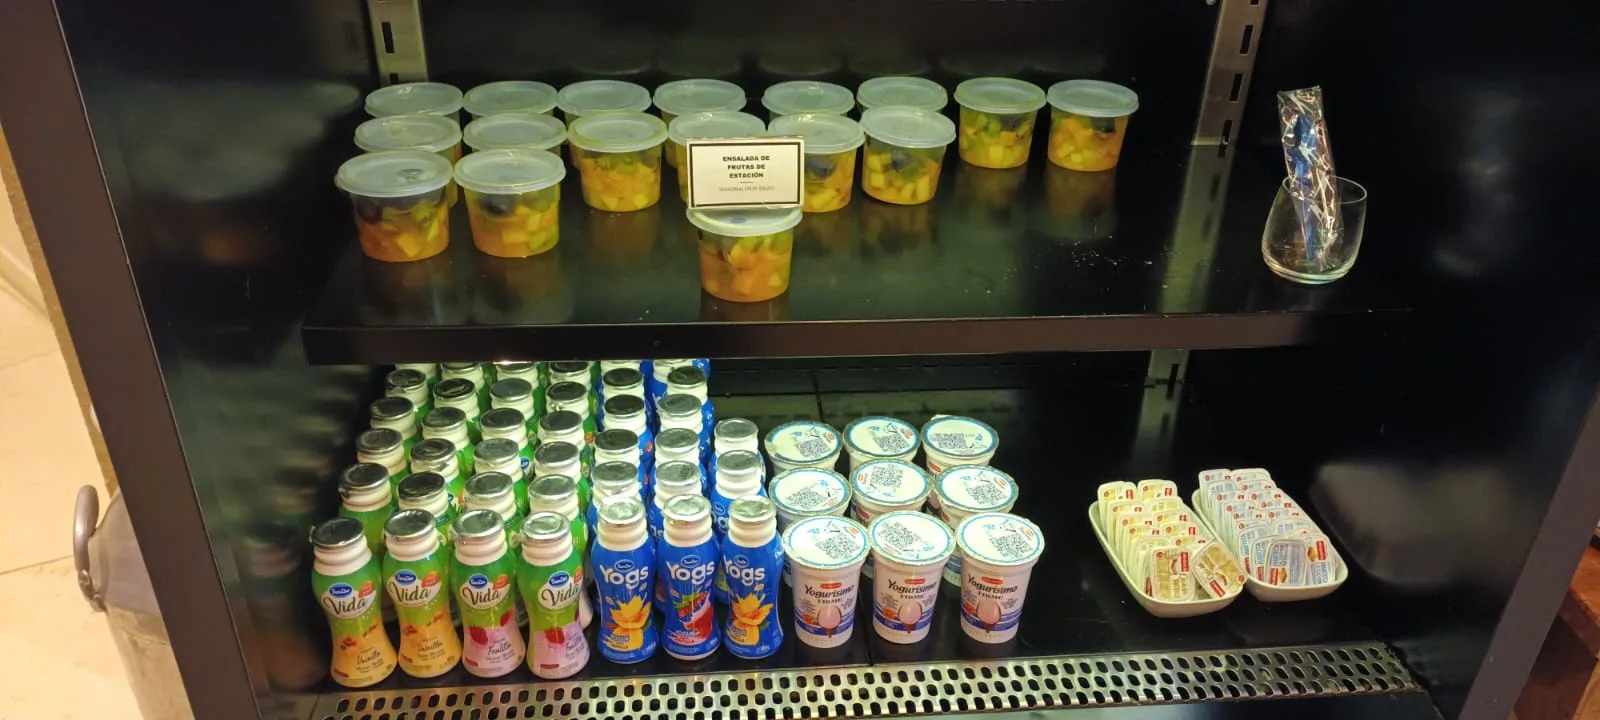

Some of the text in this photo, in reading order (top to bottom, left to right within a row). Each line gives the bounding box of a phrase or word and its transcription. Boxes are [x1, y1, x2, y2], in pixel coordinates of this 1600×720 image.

[729, 171, 764, 179] ESTACIÓN
[599, 564, 649, 590] Yogs
[666, 560, 715, 585] Yogs
[723, 554, 766, 586] Yogs
[388, 581, 431, 602] Vida
[462, 586, 501, 606] Vida
[541, 583, 580, 606] Vida
[323, 596, 368, 615] Vida
